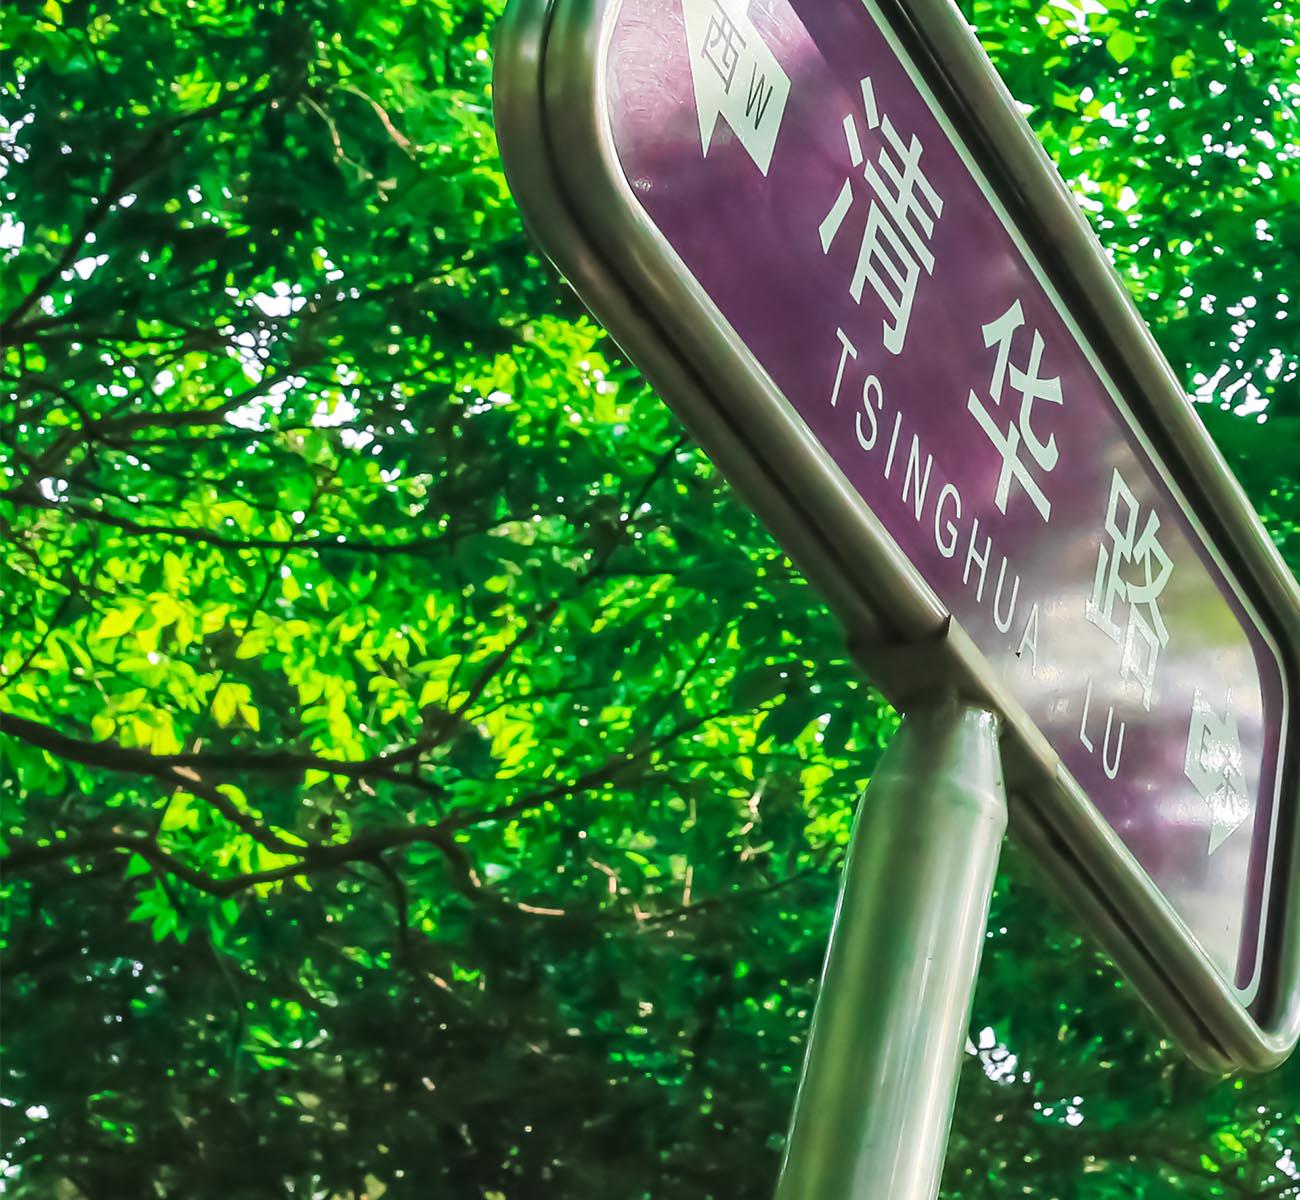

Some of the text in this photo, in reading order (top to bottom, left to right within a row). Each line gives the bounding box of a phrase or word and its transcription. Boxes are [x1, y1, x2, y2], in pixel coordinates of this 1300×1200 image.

[746, 62, 774, 131] W
[818, 76, 1174, 712] 清华路
[831, 327, 1126, 780] TSINGHUA LU
